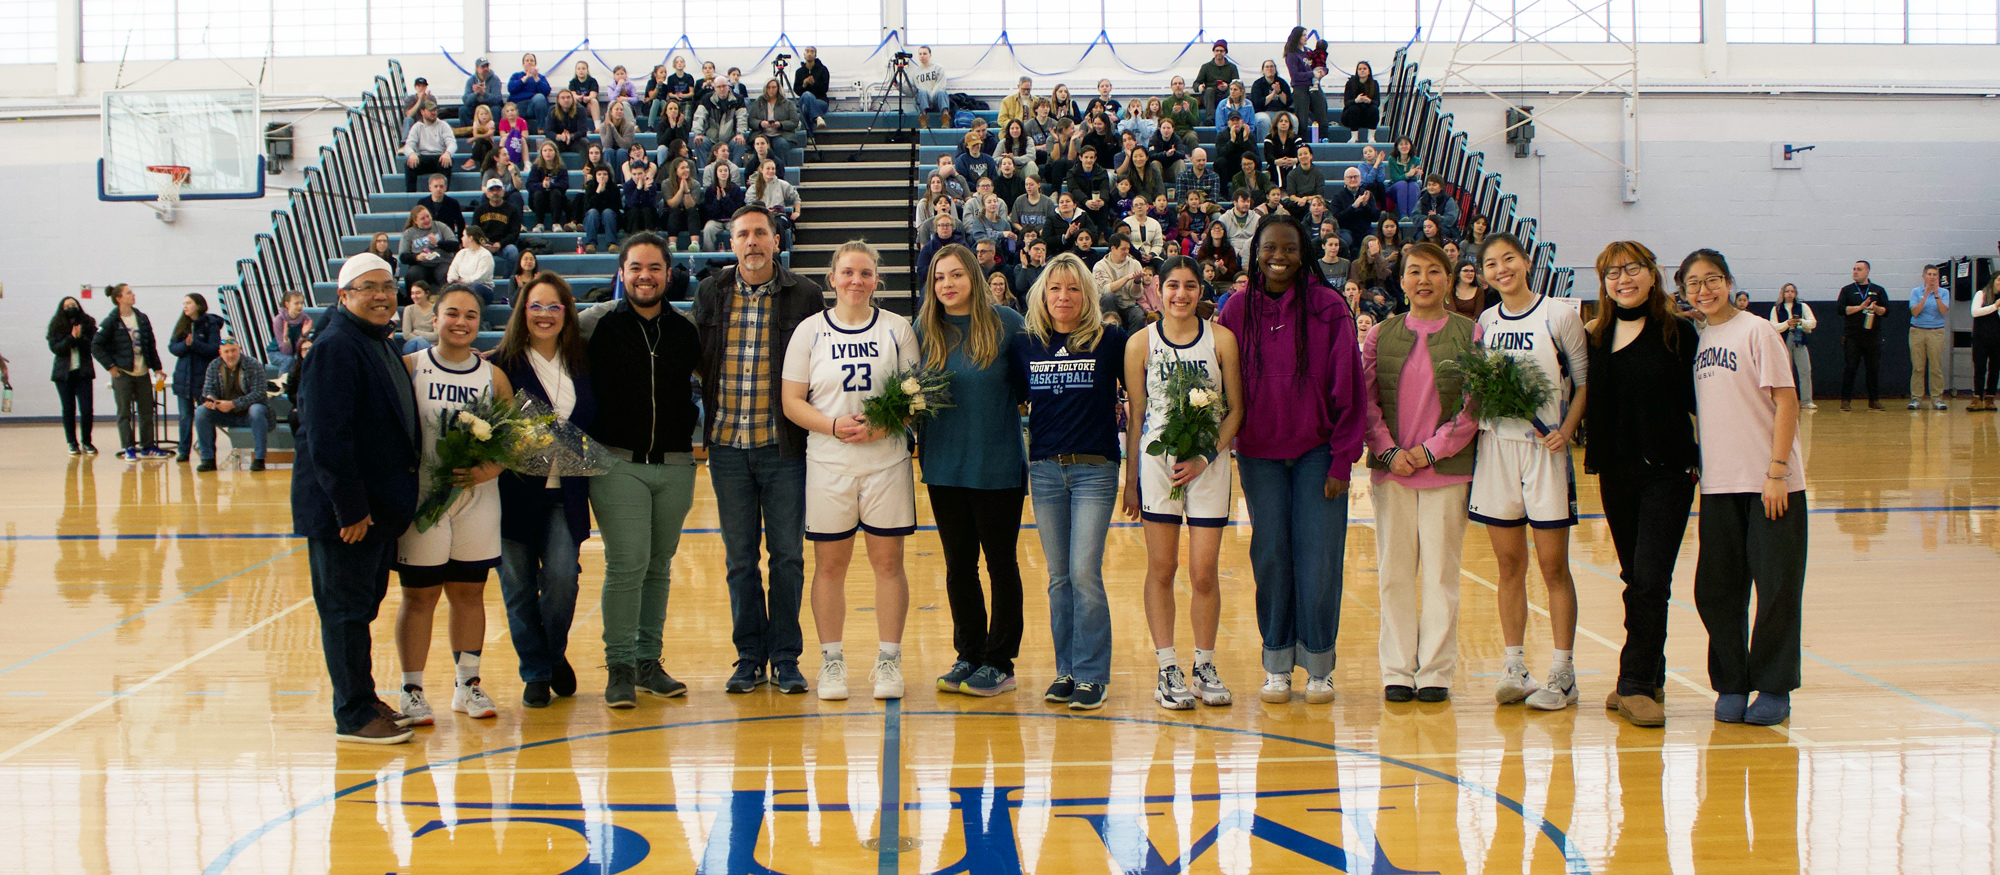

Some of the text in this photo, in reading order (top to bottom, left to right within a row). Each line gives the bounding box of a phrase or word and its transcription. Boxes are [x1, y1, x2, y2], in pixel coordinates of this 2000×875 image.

[1490, 331, 1534, 350] LYONS
[832, 341, 879, 360] LYONS
[841, 363, 872, 392] 23
[1030, 362, 1095, 374] MOUNT HOLYOKE
[1030, 372, 1094, 385] BASKETBALL
[428, 382, 478, 404] LYONS
